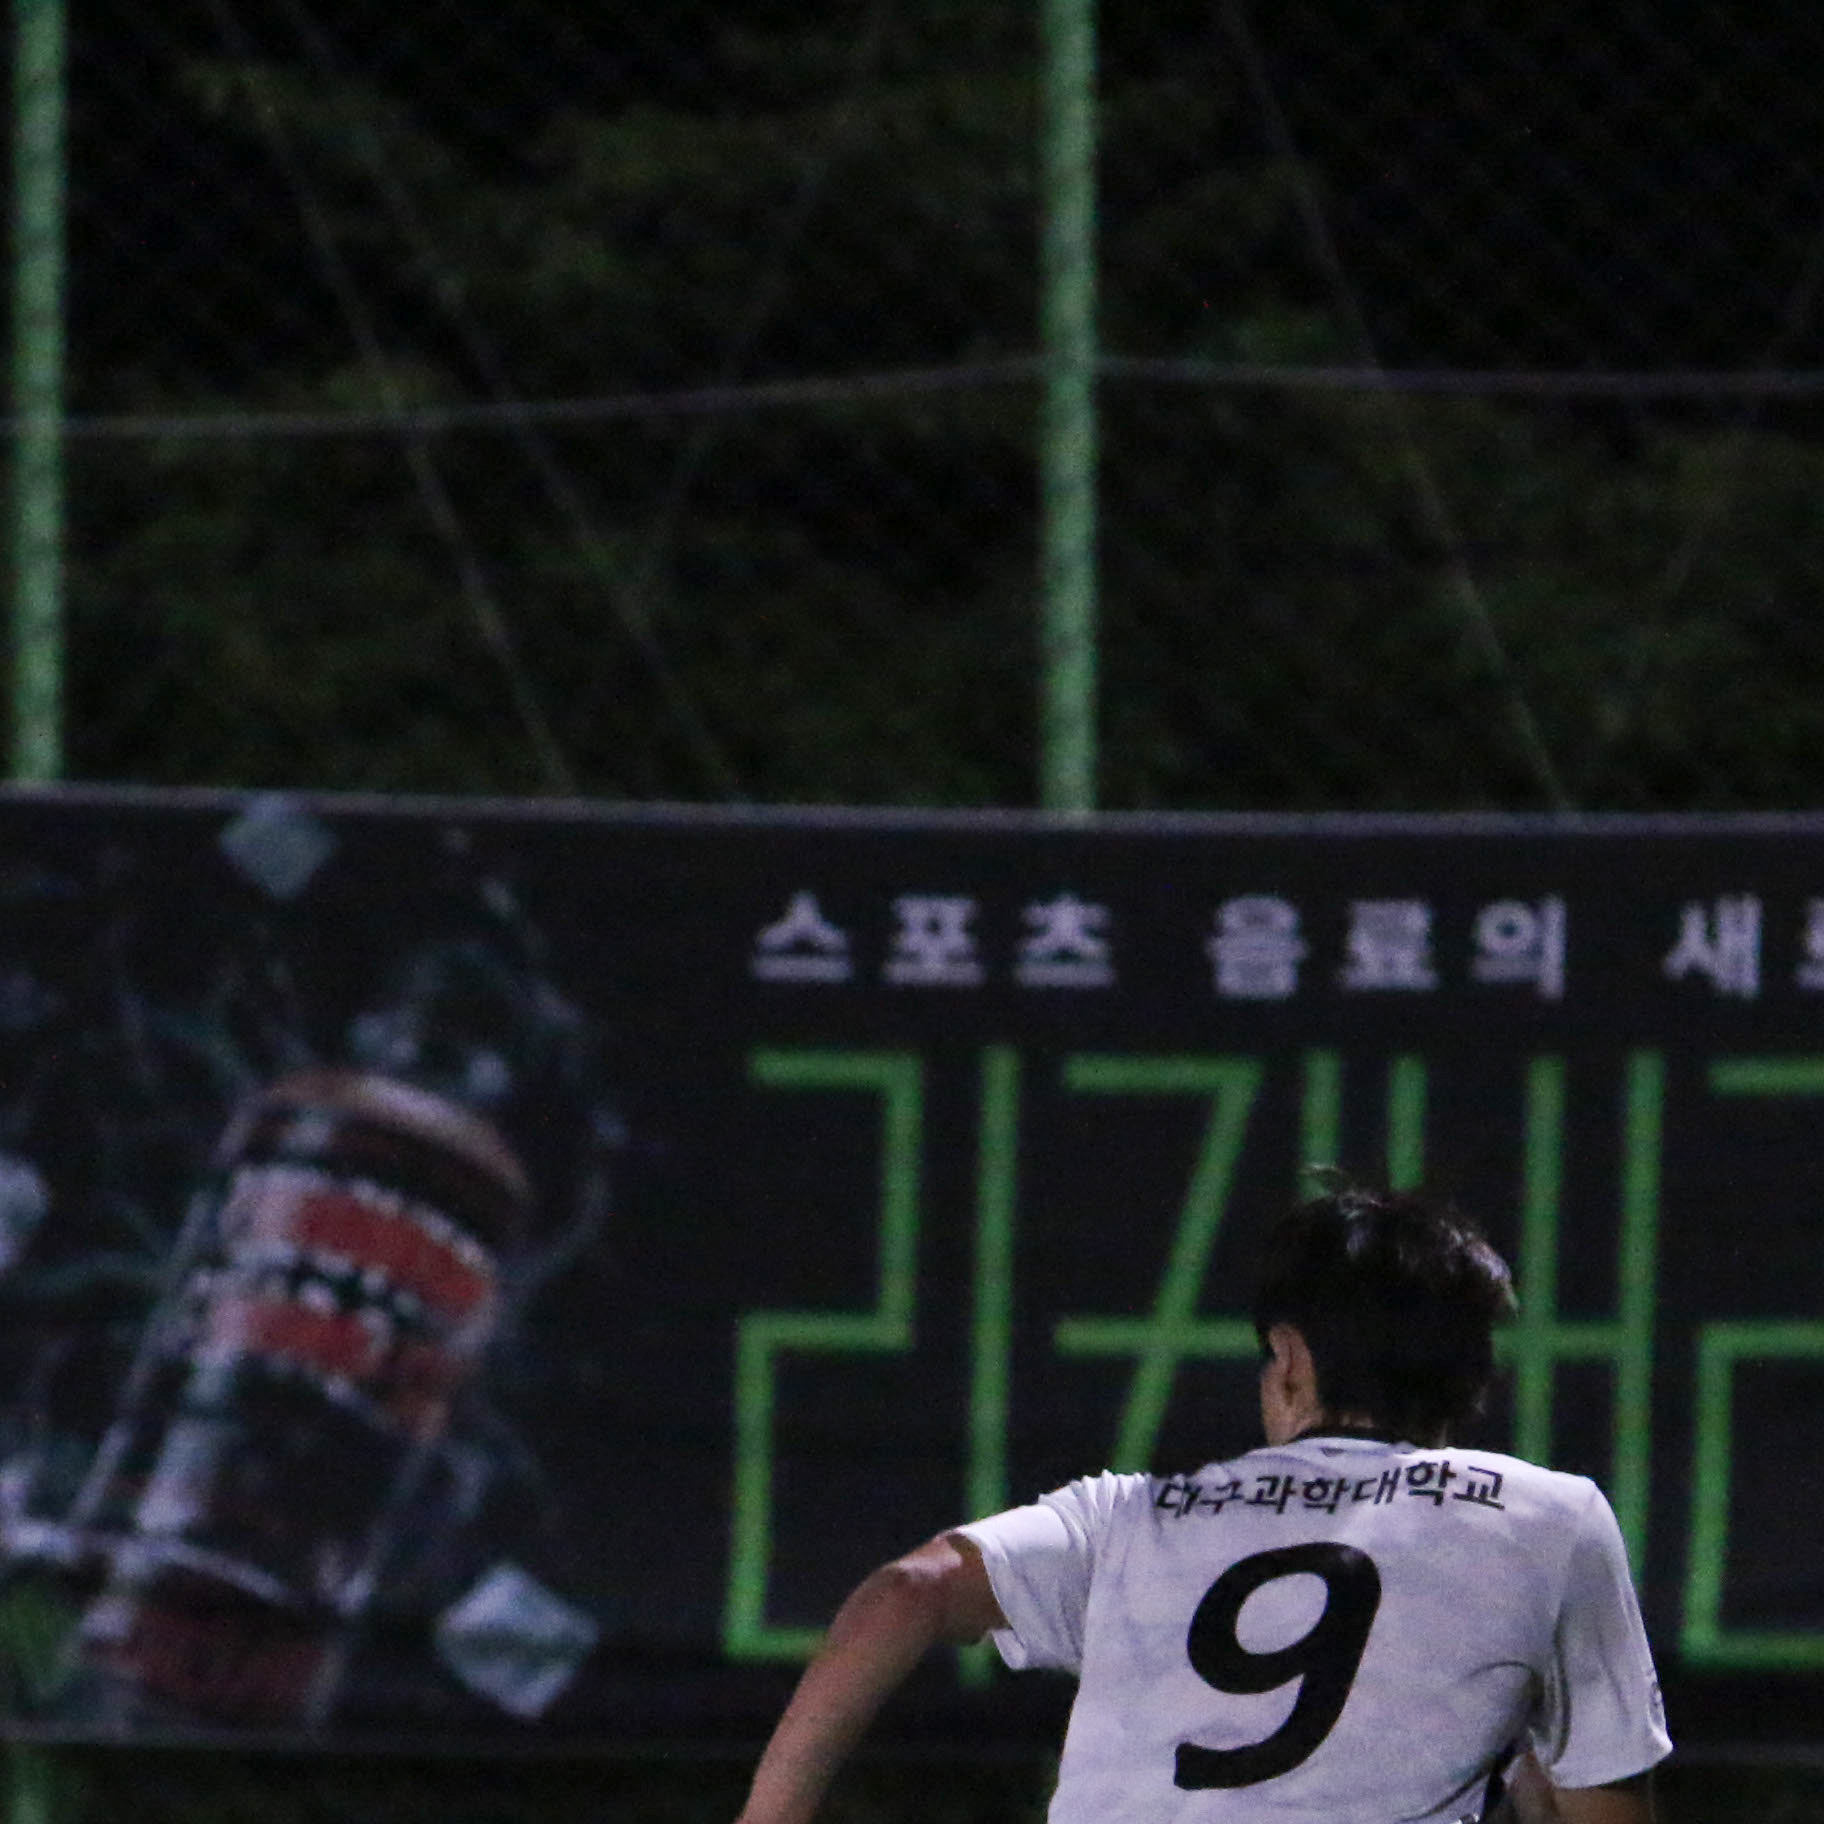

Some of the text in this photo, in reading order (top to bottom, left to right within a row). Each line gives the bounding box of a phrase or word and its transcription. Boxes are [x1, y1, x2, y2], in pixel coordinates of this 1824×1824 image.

[750, 889, 1117, 991] 스포츠
[1205, 893, 1567, 999] 음료의
[1155, 1459, 1505, 1518] 대구과학대학교
[1174, 1542, 1382, 1791] 9
